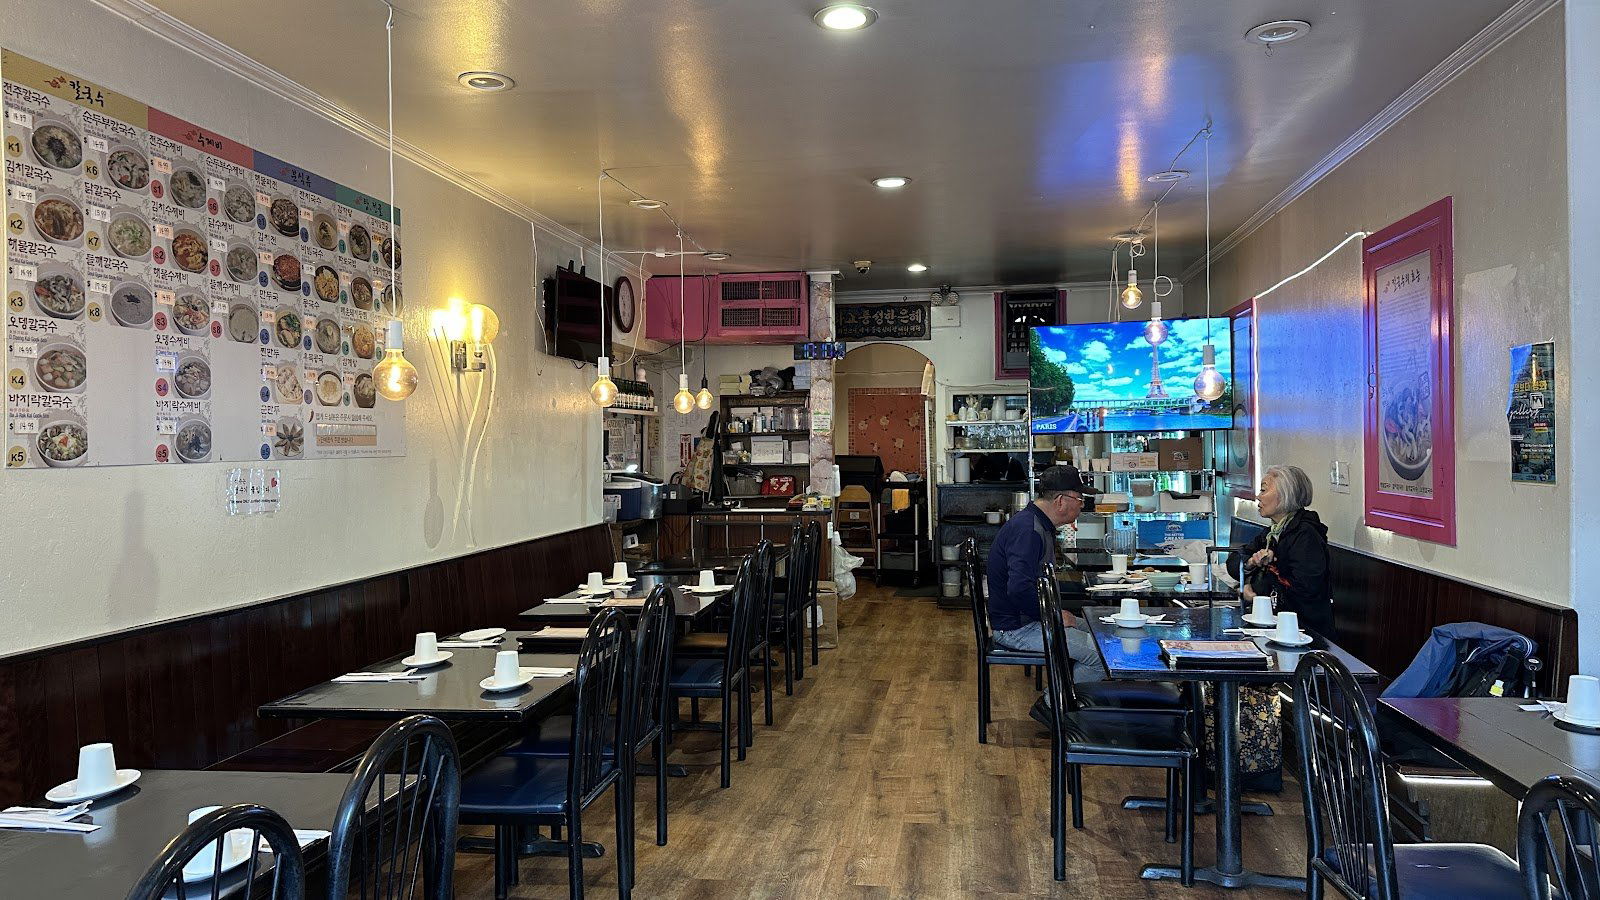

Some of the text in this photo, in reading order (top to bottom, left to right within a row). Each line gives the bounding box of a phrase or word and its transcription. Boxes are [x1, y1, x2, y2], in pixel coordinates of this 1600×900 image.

[4, 82, 50, 108] 전주칼국수
[69, 80, 104, 107] 칼국수
[83, 111, 136, 138] 순두부칼국수
[8, 142, 20, 153] K1
[150, 135, 182, 156] 전주수제비
[6, 160, 52, 183] 김치칼국수
[86, 166, 98, 175] K6
[85, 182, 121, 201] 닭칼국수
[152, 201, 184, 220] 김치수제비
[10, 219, 23, 230] K2
[8, 238, 57, 258] 해물칼국수
[88, 237, 98, 246] K7
[155, 251, 164, 259] S2
[86, 254, 128, 272] 들깨칼국수
[154, 268, 188, 284] 해물수제비
[10, 297, 23, 306] K3
[260, 290, 278, 302] 만두국
[90, 308, 100, 316] K8
[8, 316, 58, 333] 오뎅칼국수
[157, 318, 165, 326] S3
[155, 334, 189, 348] 오뎅수제비
[12, 376, 24, 385] K4
[9, 394, 72, 408] 바지락칼국수
[156, 400, 200, 412] 바지락수제비
[12, 452, 24, 461] K5
